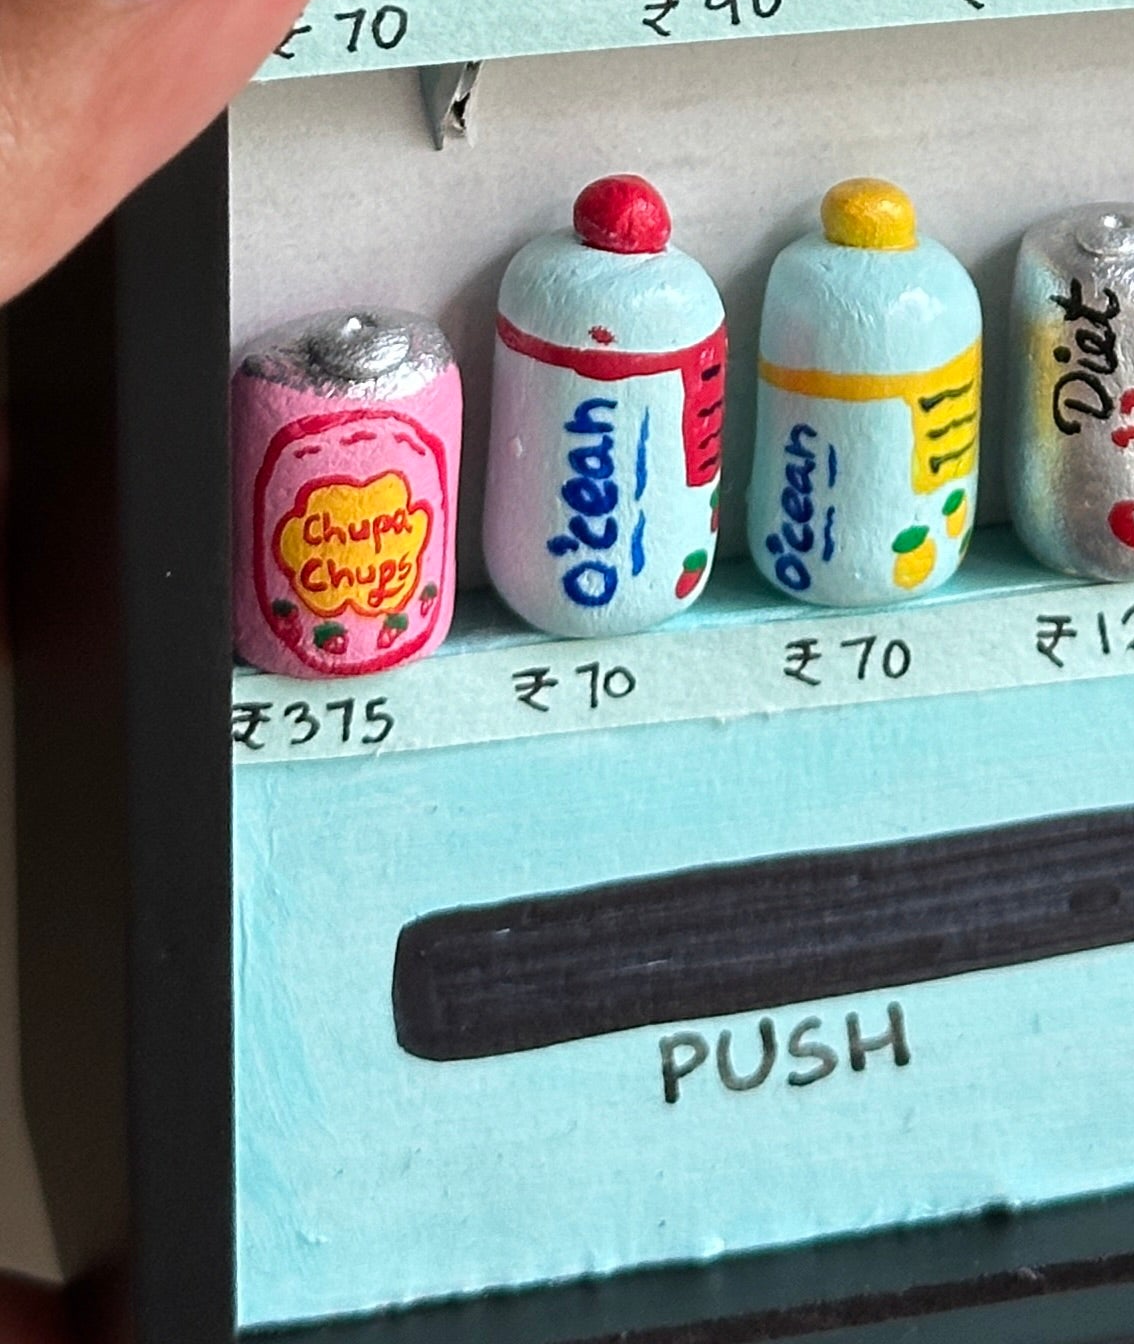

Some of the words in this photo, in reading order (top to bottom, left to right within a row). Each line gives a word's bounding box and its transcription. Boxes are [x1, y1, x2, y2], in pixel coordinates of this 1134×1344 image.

[1051, 278, 1121, 435] Diet
[302, 507, 413, 551] Chupa
[301, 552, 413, 608] Chups
[658, 1000, 911, 1105] PUSH
